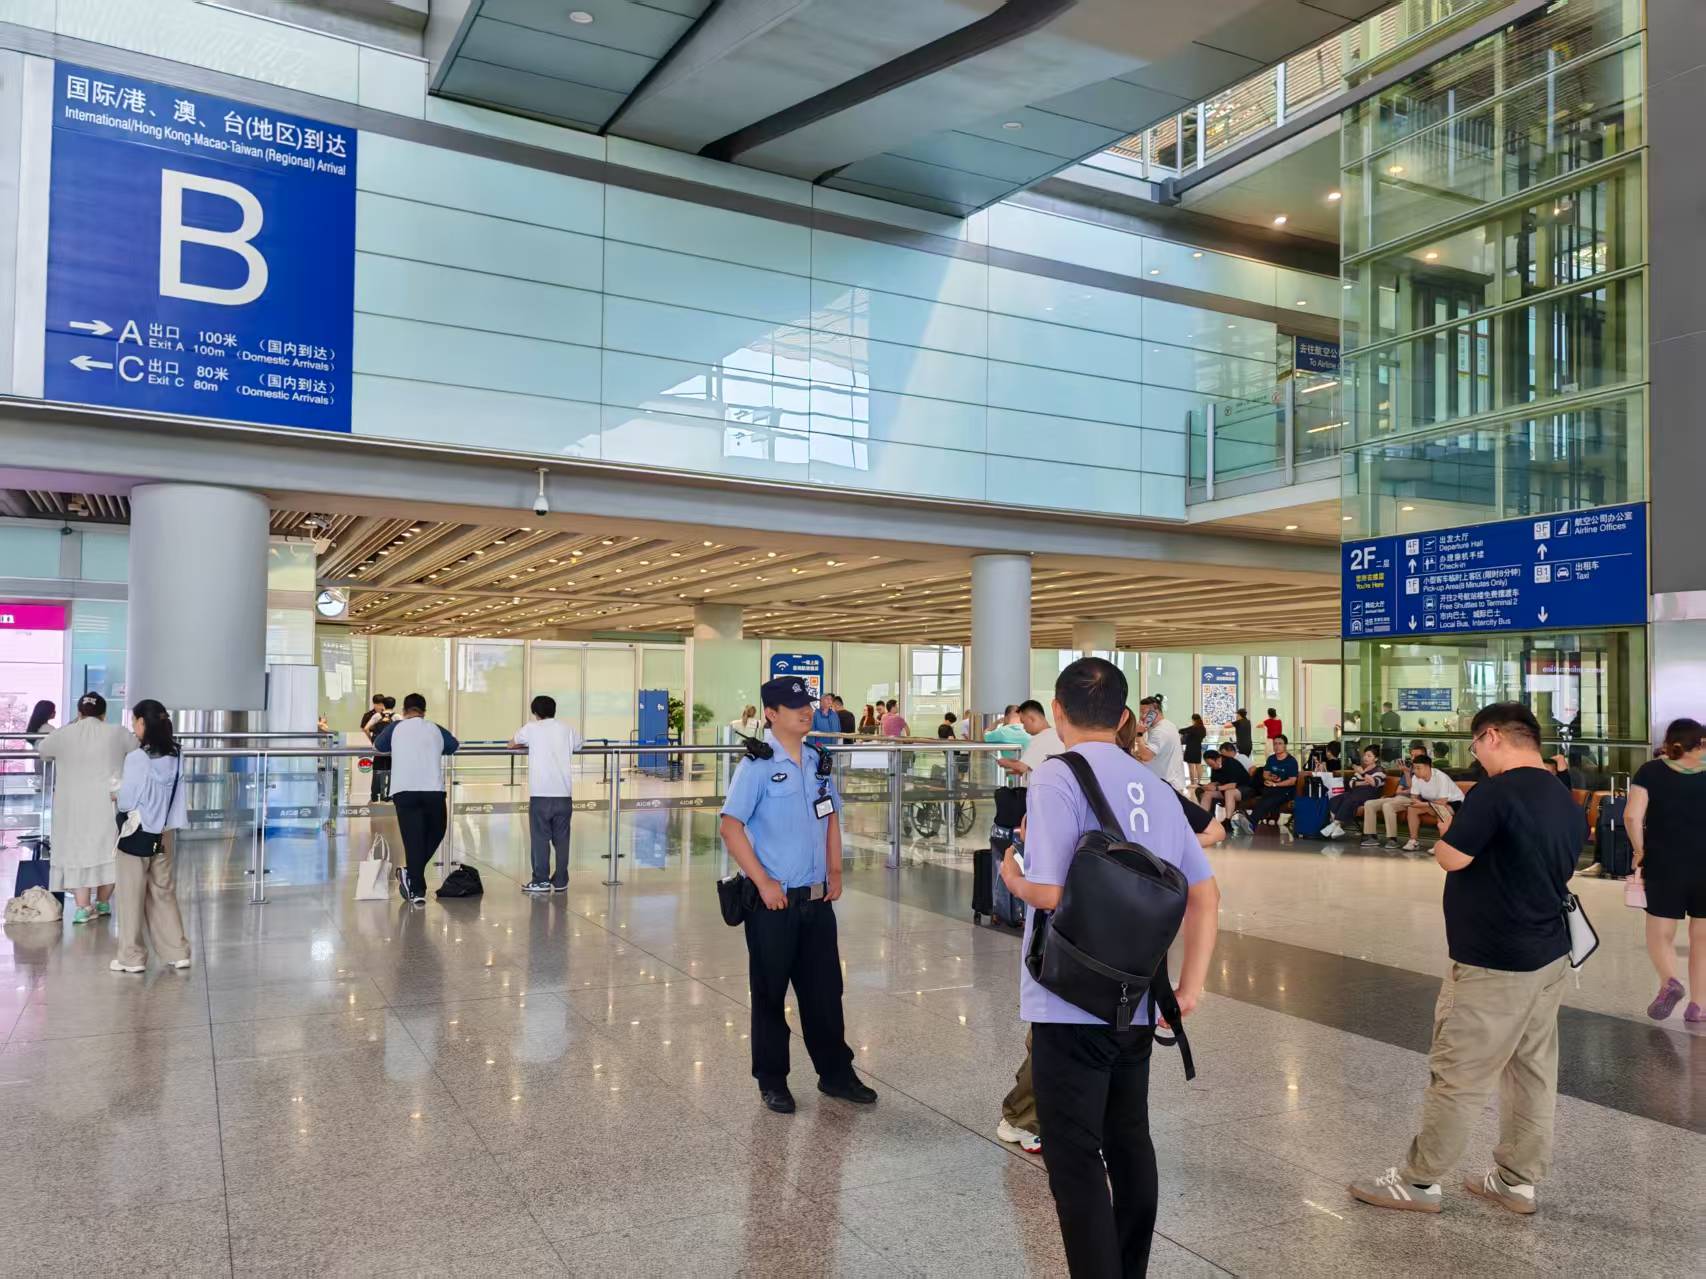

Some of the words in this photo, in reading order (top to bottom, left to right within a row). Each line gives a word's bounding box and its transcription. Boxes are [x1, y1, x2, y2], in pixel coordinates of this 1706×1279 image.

[65, 105, 162, 140] International/Hong
[164, 125, 263, 158] Kong-Macao-Taiwan
[265, 147, 315, 171] (Regional)
[317, 159, 346, 176] Arrival
[160, 168, 269, 306] B
[118, 319, 144, 347] A
[149, 322, 180, 339] 出口
[199, 330, 237, 348] 100米
[148, 338, 172, 350] Exit
[175, 341, 185, 352] A
[193, 344, 225, 358] 100m
[236, 349, 290, 367] (Domestic
[291, 357, 336, 373] Arrivals)
[118, 355, 145, 383] C
[148, 358, 179, 375] 出口
[196, 365, 229, 382] 80米
[148, 374, 170, 386] Exit
[175, 377, 185, 388] C
[193, 379, 219, 392] 80m
[236, 384, 290, 401] (Domestic
[291, 393, 336, 406] Arrivals)
[1574, 526, 1598, 535] Airline
[1599, 522, 1627, 532] Offices
[1350, 546, 1377, 571] 2F
[1439, 542, 1470, 552] Departure
[1470, 540, 1484, 549] Hall
[1439, 562, 1466, 571] Check-in
[1575, 572, 1590, 580] Taxi
[1439, 602, 1453, 610] Free
[1478, 600, 1485, 608] to
[1486, 598, 1513, 607] Terminal
[1439, 621, 1456, 629] Local
[1498, 617, 1512, 626] Bus
